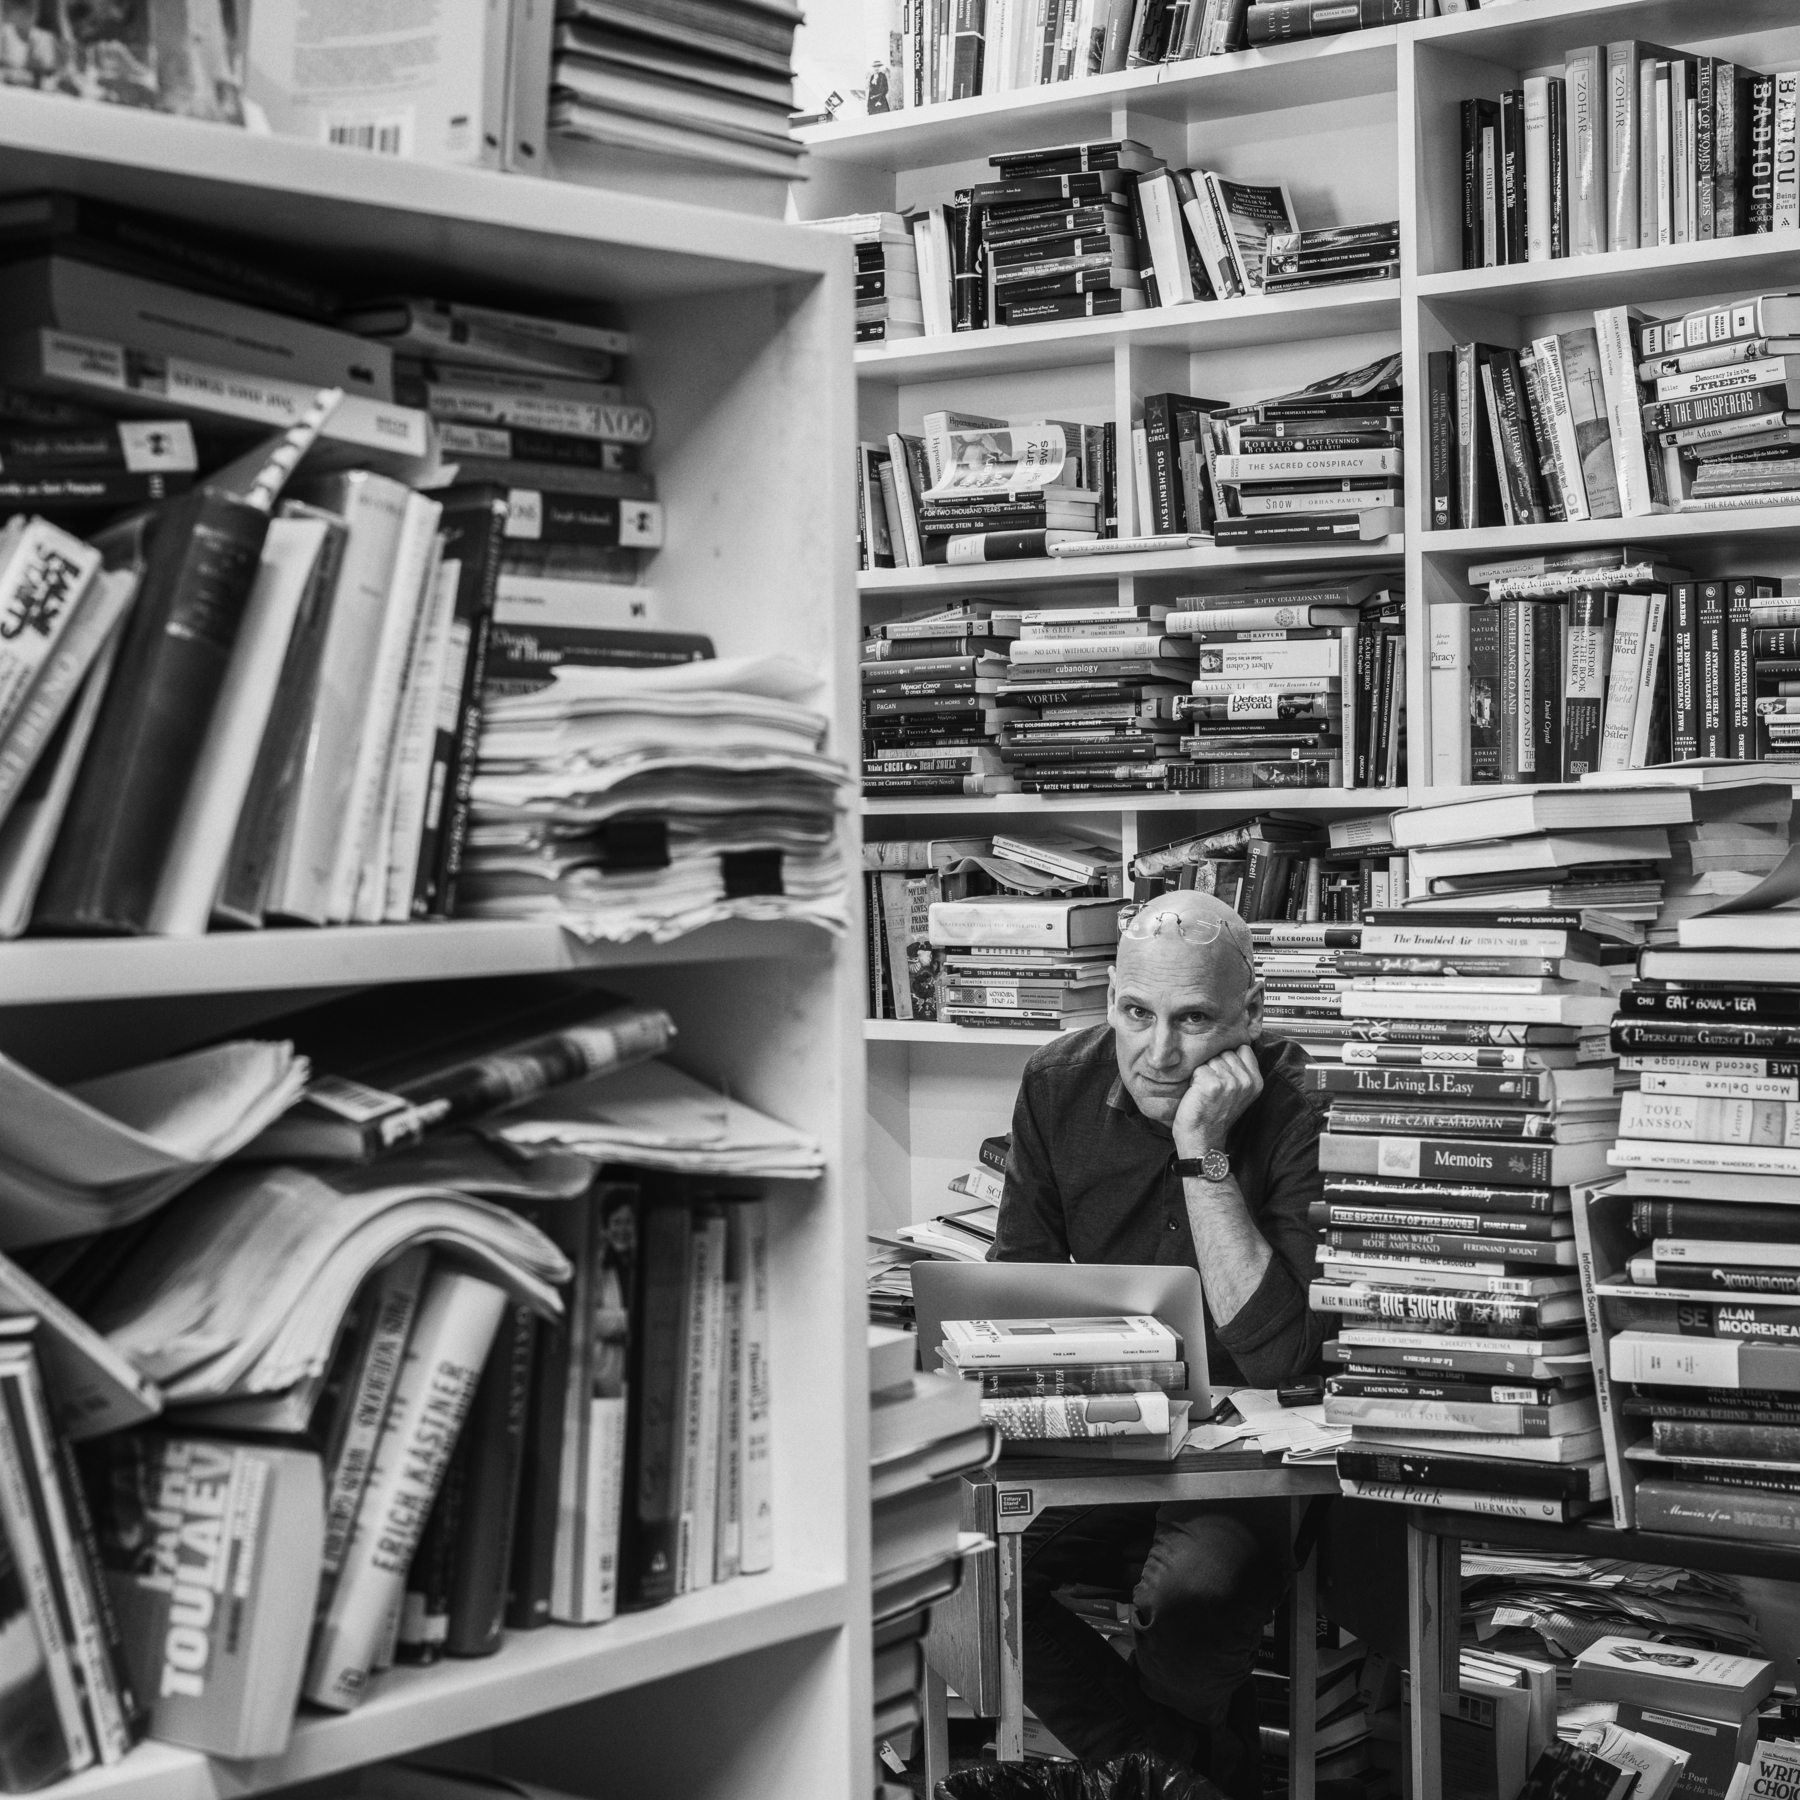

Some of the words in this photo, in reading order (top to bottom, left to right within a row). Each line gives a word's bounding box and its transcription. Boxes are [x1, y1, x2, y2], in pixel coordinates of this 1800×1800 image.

[1702, 65, 1710, 82] THE
[1702, 83, 1710, 109] CITY
[1578, 82, 1587, 133] ZOHAR
[1702, 112, 1710, 128] OF
[1752, 82, 1772, 200] BADIOU
[1702, 130, 1711, 172] WOMEN
[1702, 175, 1710, 216] LANDES
[1690, 374, 1757, 392] STREETS
[1695, 372, 1725, 382] Democracy
[1526, 379, 1535, 400] THE
[1674, 402, 1692, 423] THE
[1694, 392, 1754, 420] WHISPERERS
[1501, 368, 1516, 423] MEDIEVAL
[1510, 425, 1524, 468] HERESY
[1530, 404, 1543, 442] FAMILY
[1148, 434, 1169, 442] CIRCLE
[1697, 428, 1722, 439] Adams
[1244, 440, 1294, 448] ROBERTO
[1268, 462, 1302, 470] SACRED
[1306, 460, 1364, 468] CONSPIRACY
[1157, 450, 1169, 528] SOLZHENITSYN
[1266, 499, 1292, 510] Snow
[951, 508, 982, 516] THOUSAND
[1568, 575, 1600, 584] Harvard
[1602, 572, 1633, 581] Square
[1500, 580, 1526, 592] André
[1528, 578, 1562, 588] Aciman
[1574, 631, 1579, 641] IN
[1677, 632, 1683, 644] OF
[1614, 646, 1636, 654] Word
[1431, 652, 1456, 664] Piracy
[1056, 664, 1098, 673] cubanology
[1026, 694, 1068, 704] VORTEX
[1232, 702, 1272, 712] Beyond
[1604, 730, 1628, 740] Ostler
[1249, 848, 1260, 878] Brazell
[910, 905, 928, 913] LOVES
[1393, 934, 1412, 944] The
[1414, 934, 1454, 945] Troubled
[1457, 936, 1472, 945] Air
[1638, 996, 1654, 1006] CHU
[1666, 996, 1688, 1010] EAT
[1734, 998, 1756, 1010] TEA
[1654, 1056, 1710, 1069] Marriage
[1716, 1061, 1759, 1072] Second
[1354, 1070, 1381, 1090] The
[1383, 1072, 1426, 1094] Living
[1428, 1074, 1442, 1092] Is
[1444, 1074, 1474, 1096] Easy
[1706, 1080, 1748, 1094] Deluxe
[1756, 1084, 1790, 1094] Moon
[1645, 1105, 1682, 1116] TOVE
[1628, 1118, 1692, 1130] JANSSON
[1434, 1151, 1493, 1169] Memoirs
[1334, 1212, 1352, 1220] THE
[1355, 1213, 1406, 1224] SPECIALTY
[1408, 1216, 1420, 1224] OF
[1421, 1217, 1440, 1226] THE
[1442, 1219, 1474, 1229] HOUSE
[1371, 1232, 1386, 1240] THE
[1389, 1234, 1409, 1242] MAN
[1412, 1236, 1434, 1244] WHO
[1363, 1240, 1386, 1248] RODE
[1388, 1242, 1440, 1252] AMPERSAND
[1464, 1244, 1506, 1254] FERDINAND
[1509, 1248, 1538, 1256] MOUNT
[1582, 1252, 1594, 1294] Informed
[1588, 1296, 1598, 1334] Sources
[1322, 1296, 1336, 1306] ALEC
[1380, 1293, 1404, 1317] BIG
[1408, 1296, 1456, 1320] SUGAR
[1718, 1308, 1754, 1321] ALAN
[990, 1376, 998, 1394] Asch
[1036, 1372, 1045, 1395] EAST
[1056, 1370, 1064, 1394] RIVER
[1356, 1481, 1396, 1500] Letti
[1402, 1486, 1443, 1505] Park
[1474, 1502, 1526, 1516] HERMANN
[1609, 1743, 1650, 1770] James
[1688, 1773, 1708, 1784] Poet
